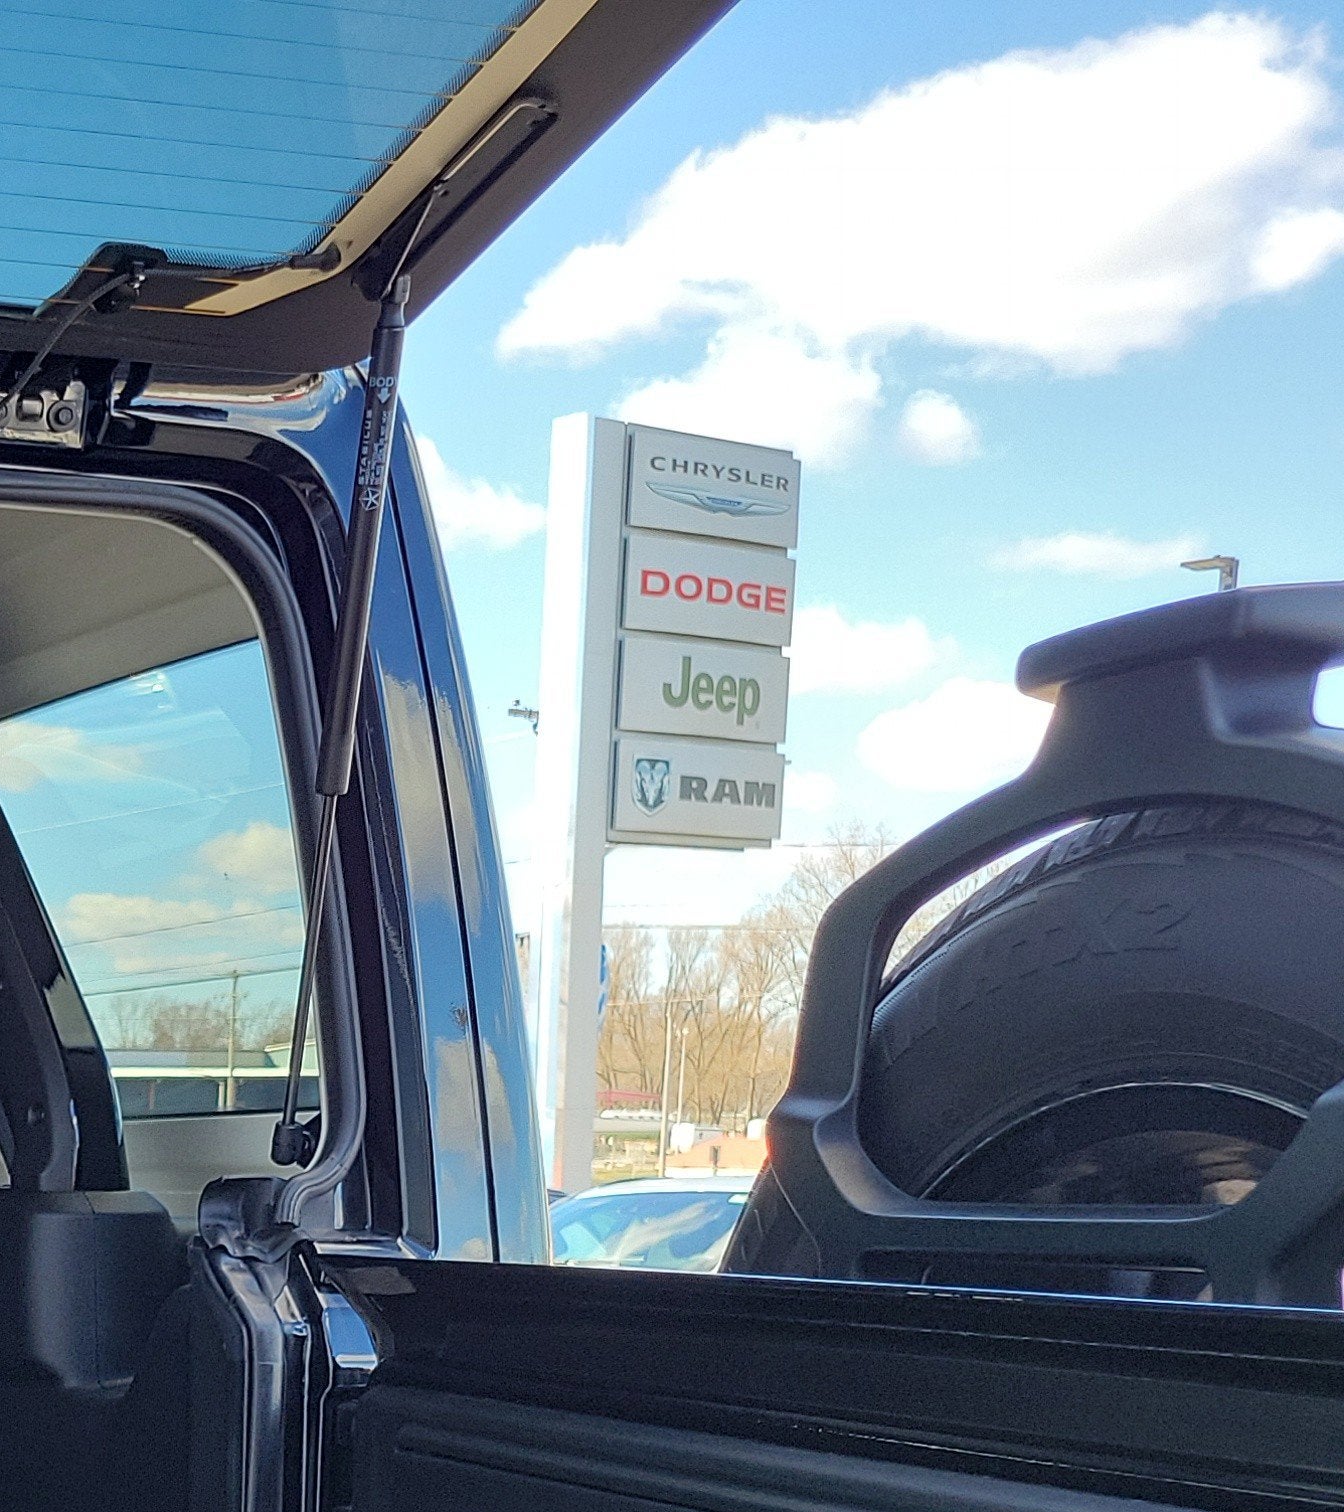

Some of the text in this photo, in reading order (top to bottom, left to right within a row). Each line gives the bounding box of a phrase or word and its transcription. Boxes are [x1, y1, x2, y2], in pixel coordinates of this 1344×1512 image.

[649, 455, 790, 493] CHRYSLER
[640, 568, 788, 614] DODGE
[662, 656, 761, 726] Jeep
[679, 775, 777, 809] RAM
